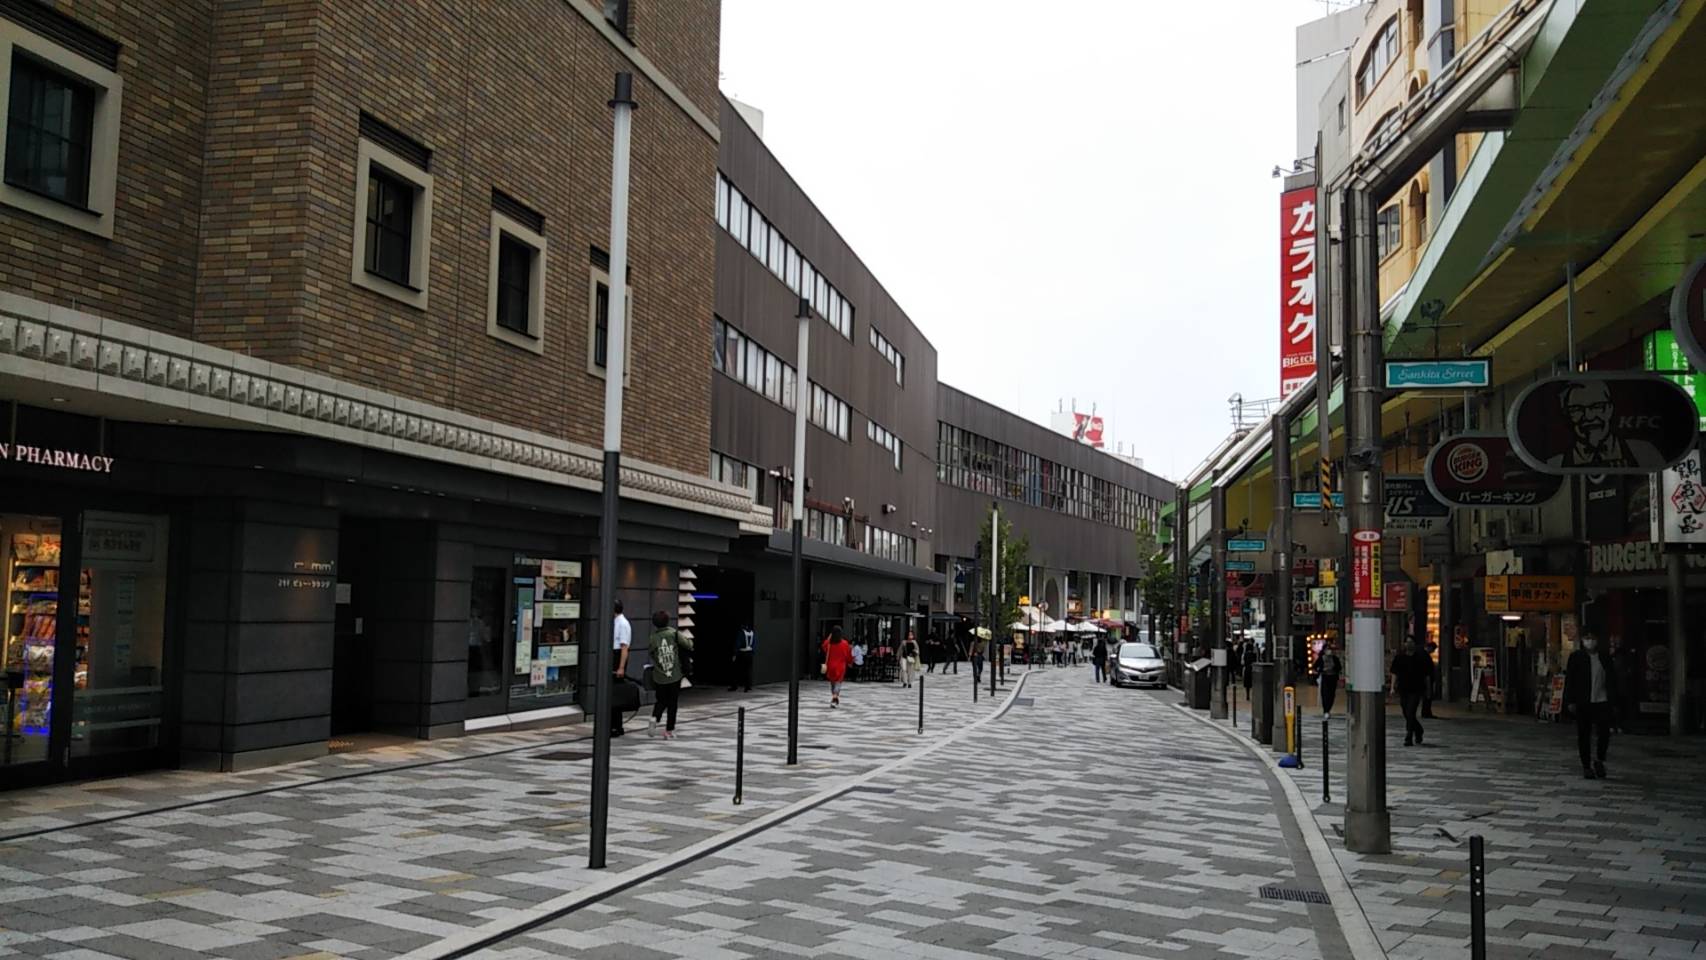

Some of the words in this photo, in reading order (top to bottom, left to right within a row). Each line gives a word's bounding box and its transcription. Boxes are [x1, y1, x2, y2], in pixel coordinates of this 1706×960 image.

[1283, 356, 1300, 368] BIG
[1442, 367, 1475, 380] Street
[1618, 415, 1662, 429] KFC
[15, 444, 114, 473] PHARMACY
[1455, 458, 1483, 473] KING
[1458, 491, 1536, 504] バーガーキング
[1592, 542, 1658, 573] BURGER
